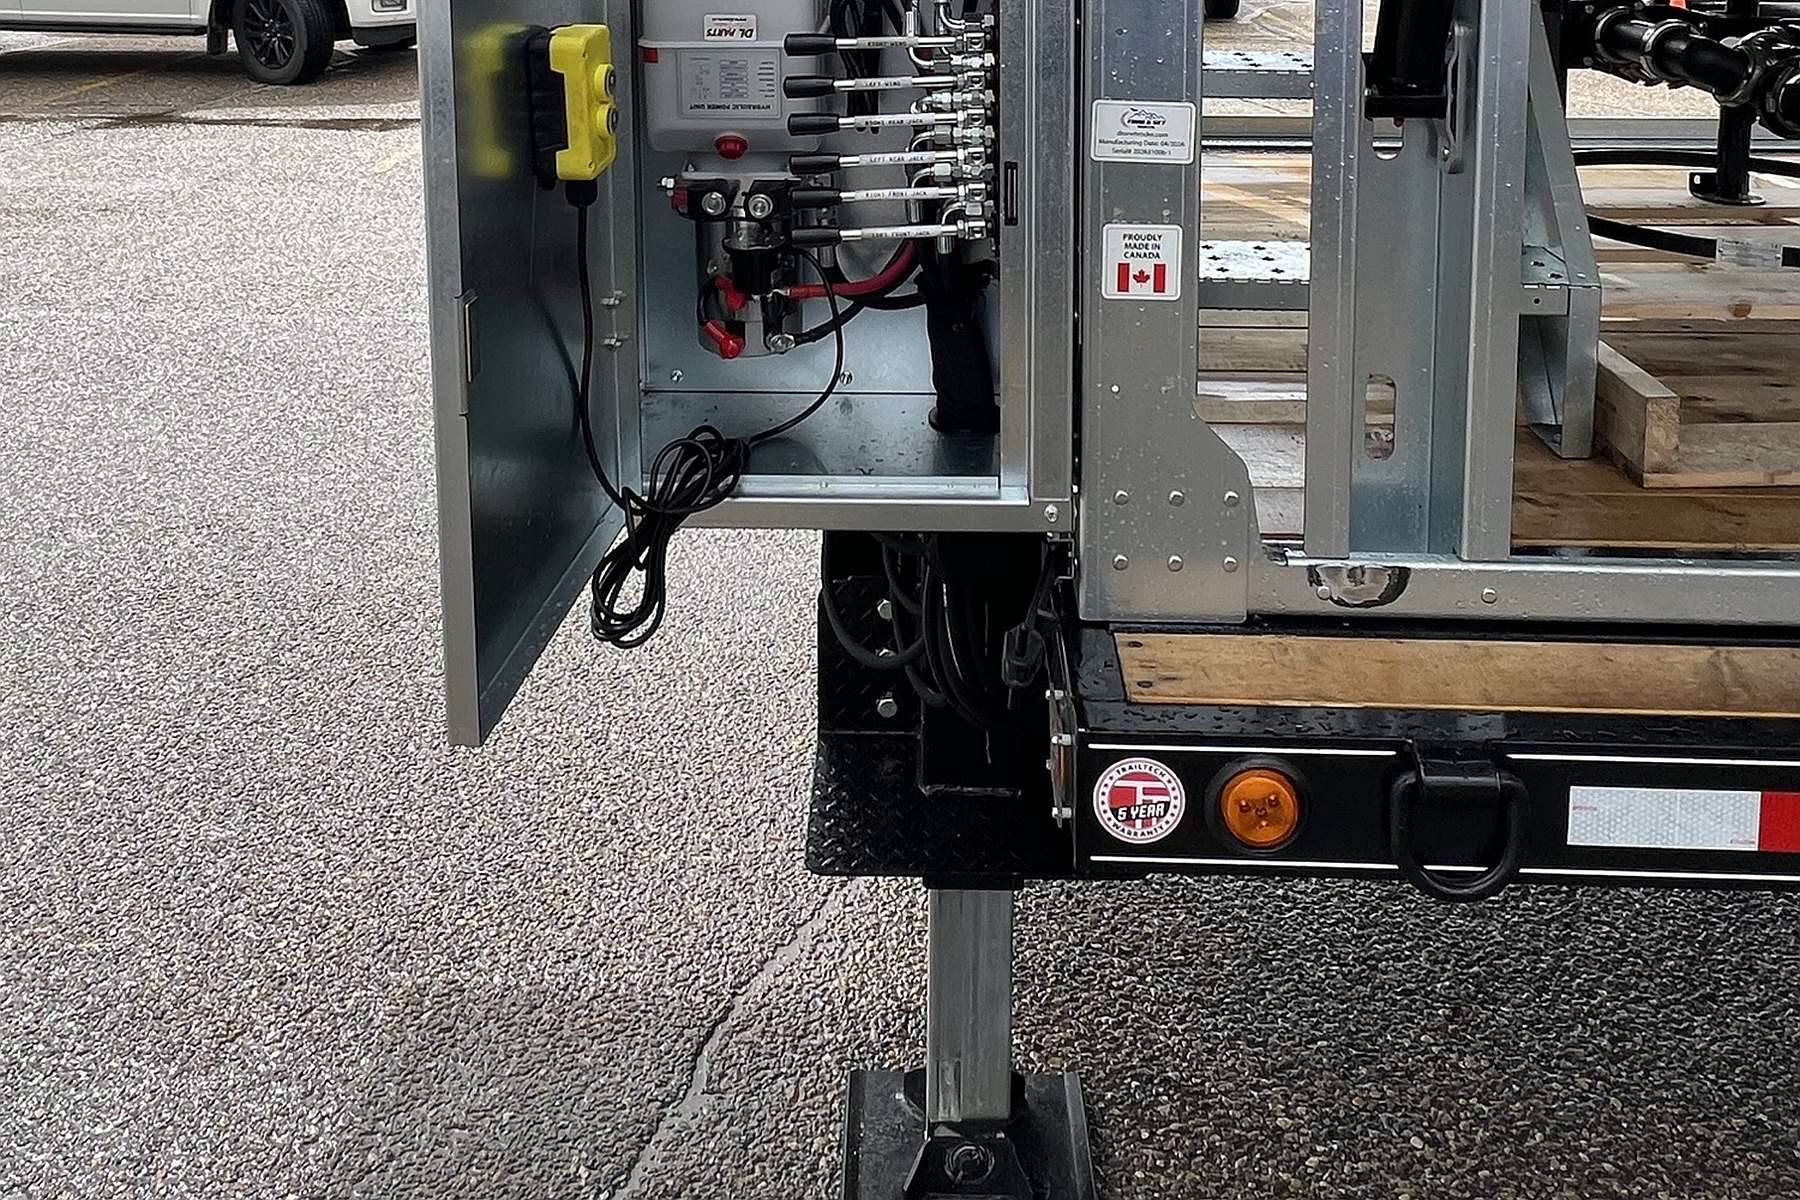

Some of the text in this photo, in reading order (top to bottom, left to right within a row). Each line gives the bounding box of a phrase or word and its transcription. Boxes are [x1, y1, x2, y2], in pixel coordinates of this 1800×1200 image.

[706, 28, 754, 39] DL PARTS
[1122, 233, 1163, 242] PROUDLY
[1123, 242, 1161, 251] MADE IN
[1123, 251, 1161, 260] CANADA
[1116, 764, 1166, 778] TRAILTECH
[1117, 802, 1165, 821] 5 YEAR
[1112, 821, 1164, 838] WARRANTY
